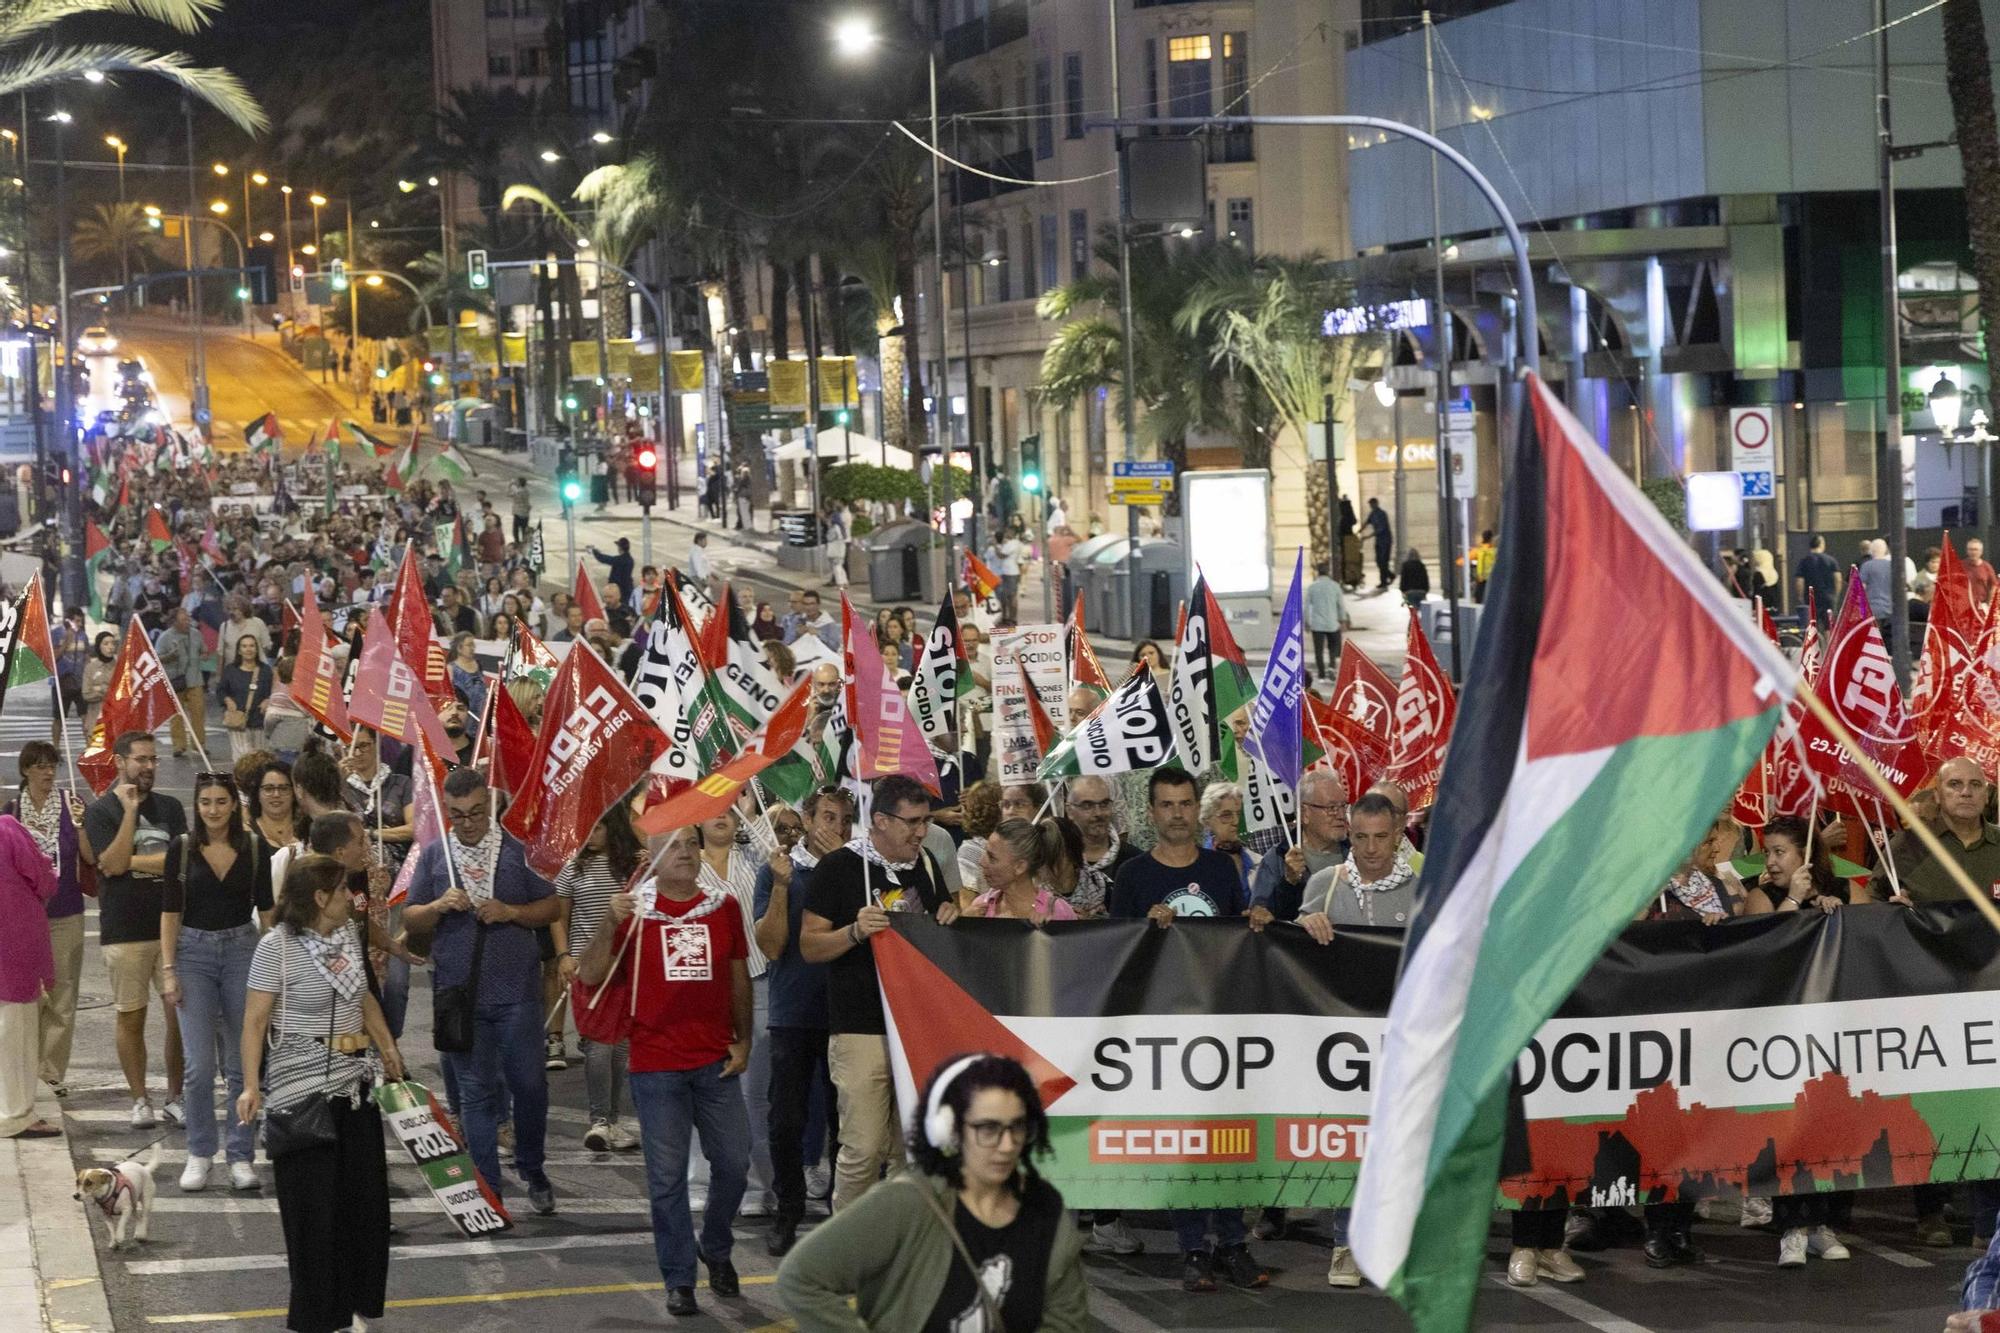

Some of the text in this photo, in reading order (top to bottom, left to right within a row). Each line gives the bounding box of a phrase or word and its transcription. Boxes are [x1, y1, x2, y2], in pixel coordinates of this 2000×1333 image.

[1025, 632, 1056, 645] STOP
[669, 969, 708, 977] CCOO
[1090, 1036, 1275, 1091] STOP
[1726, 1024, 1946, 1083] CONTRA
[1963, 1019, 2000, 1065] E
[1098, 1129, 1207, 1155] CCOO
[1288, 1123, 1367, 1158] UGT
[463, 1208, 504, 1232] STOP
